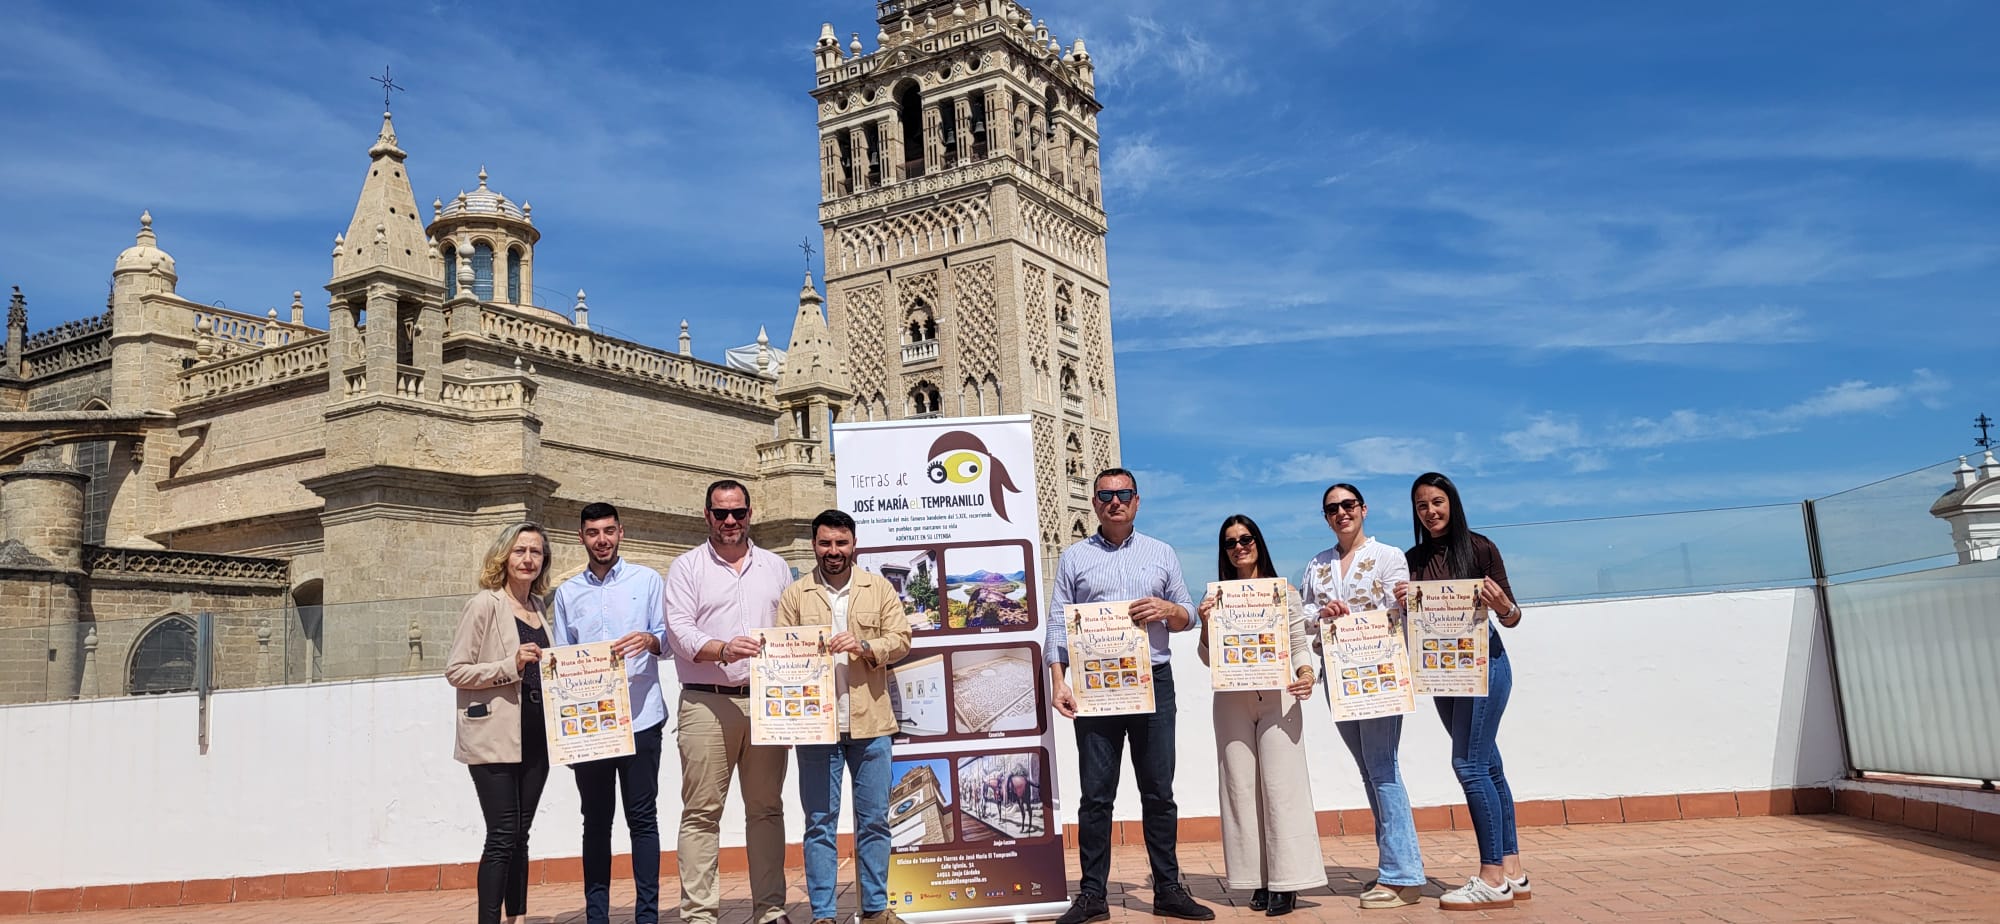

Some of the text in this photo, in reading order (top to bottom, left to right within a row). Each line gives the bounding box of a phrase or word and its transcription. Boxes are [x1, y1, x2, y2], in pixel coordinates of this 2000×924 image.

[850, 472, 908, 488] Tierras de
[853, 496, 874, 512] JOSÉ
[878, 494, 909, 511] MARÍA
[920, 494, 984, 509] TEMPRANILLO
[577, 649, 590, 657] IX
